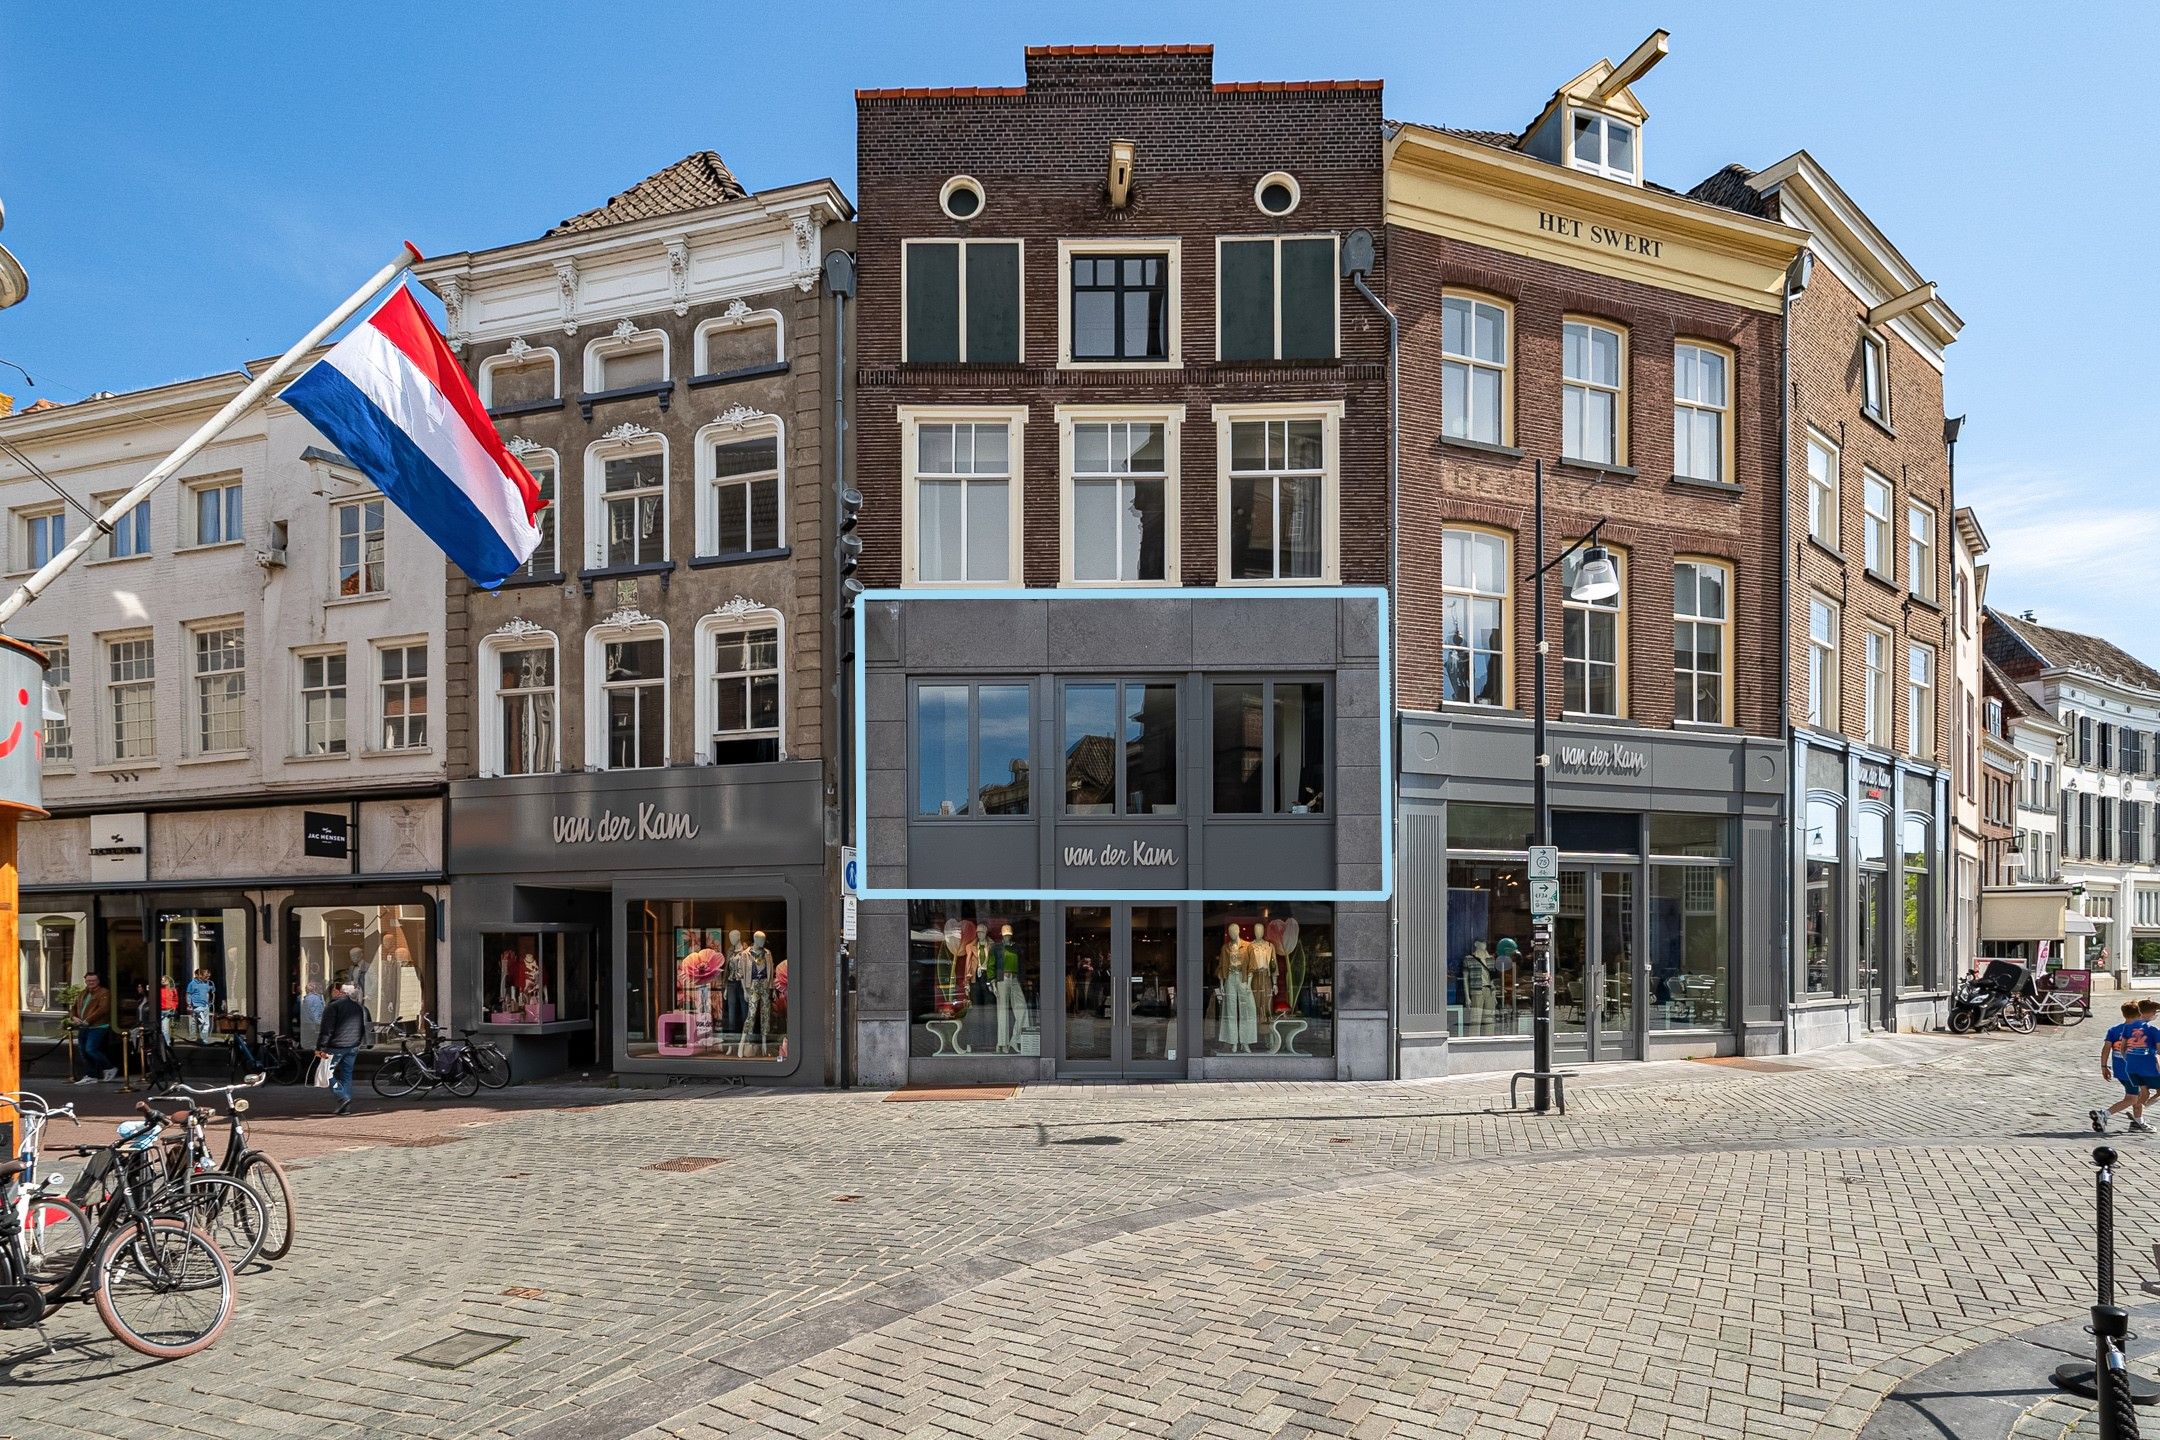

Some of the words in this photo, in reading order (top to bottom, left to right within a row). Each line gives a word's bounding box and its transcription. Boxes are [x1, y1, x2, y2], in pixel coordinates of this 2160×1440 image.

[1538, 211, 1583, 238] HET
[1590, 225, 1663, 258] SWERT
[1561, 746, 1588, 766] van
[1589, 745, 1613, 767] der
[1613, 743, 1649, 770] Kam
[553, 815, 595, 843] van
[597, 809, 636, 843] der
[638, 801, 699, 841] Kam
[320, 834, 346, 842] HENSEN
[1064, 846, 1097, 867] van
[1100, 843, 1131, 867] der
[1133, 839, 1179, 867] Kam
